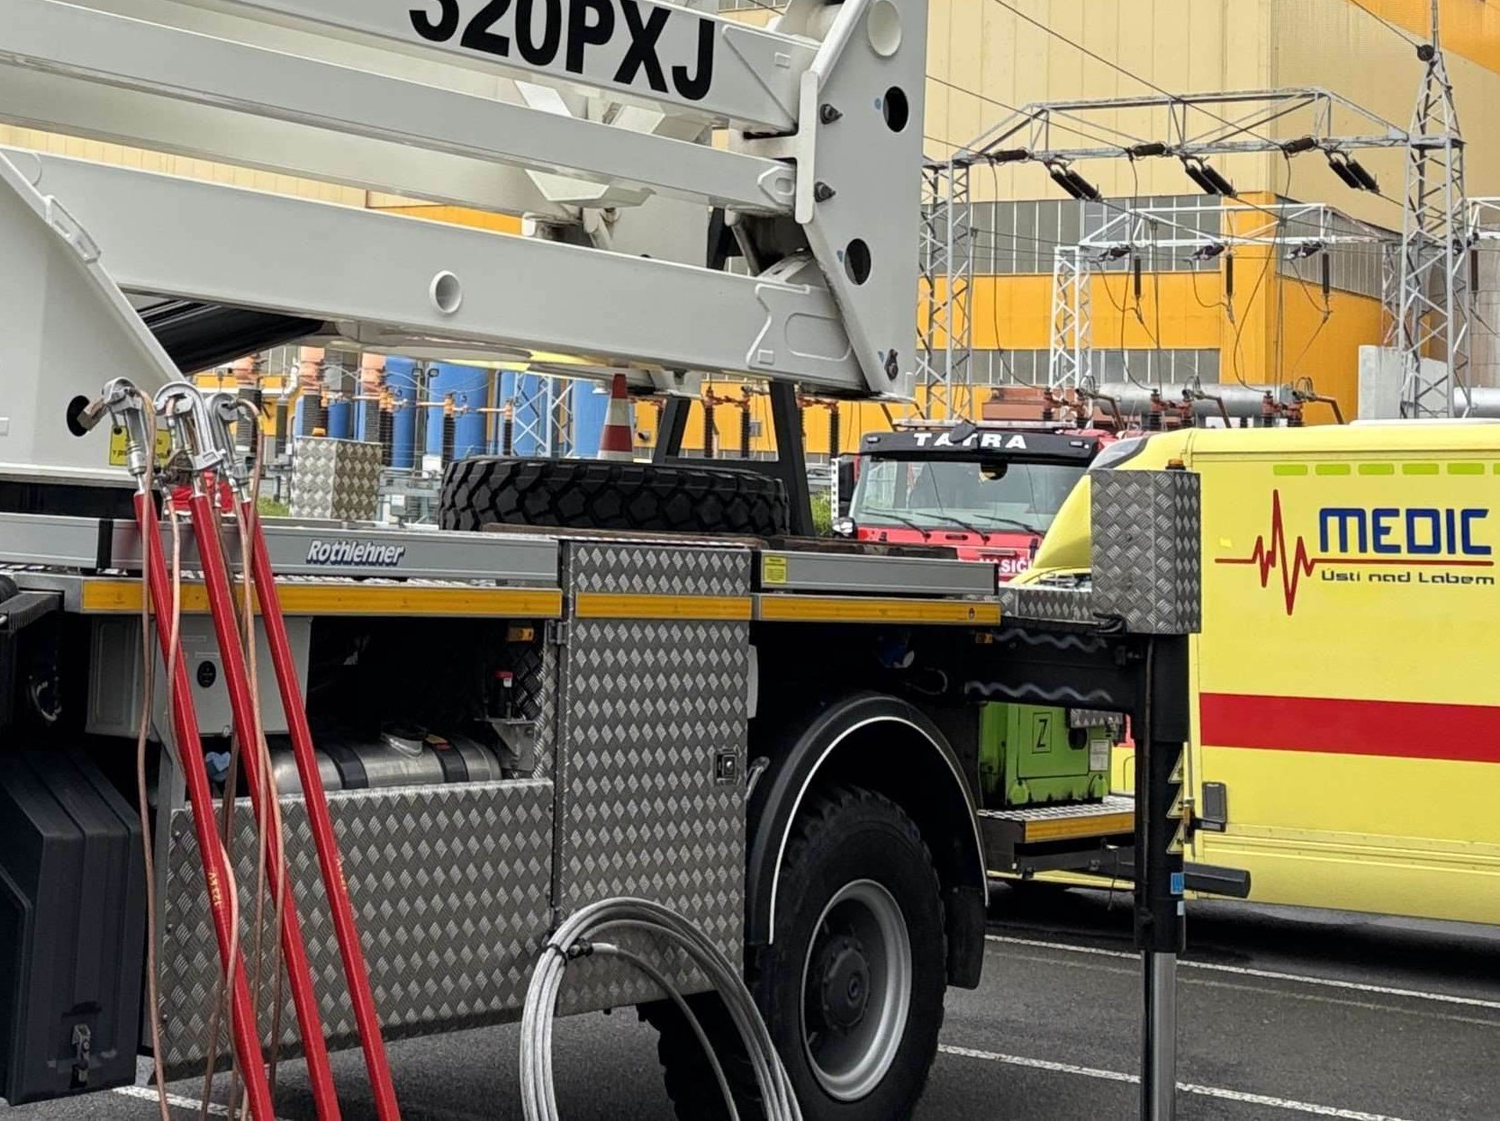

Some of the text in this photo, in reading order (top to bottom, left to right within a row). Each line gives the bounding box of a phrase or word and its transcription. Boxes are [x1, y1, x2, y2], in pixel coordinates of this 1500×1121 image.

[1319, 508, 1492, 555] MEDIC
[306, 540, 405, 567] Rothlehner
[1368, 571, 1411, 583] nad
[1418, 572, 1495, 585] Labem
